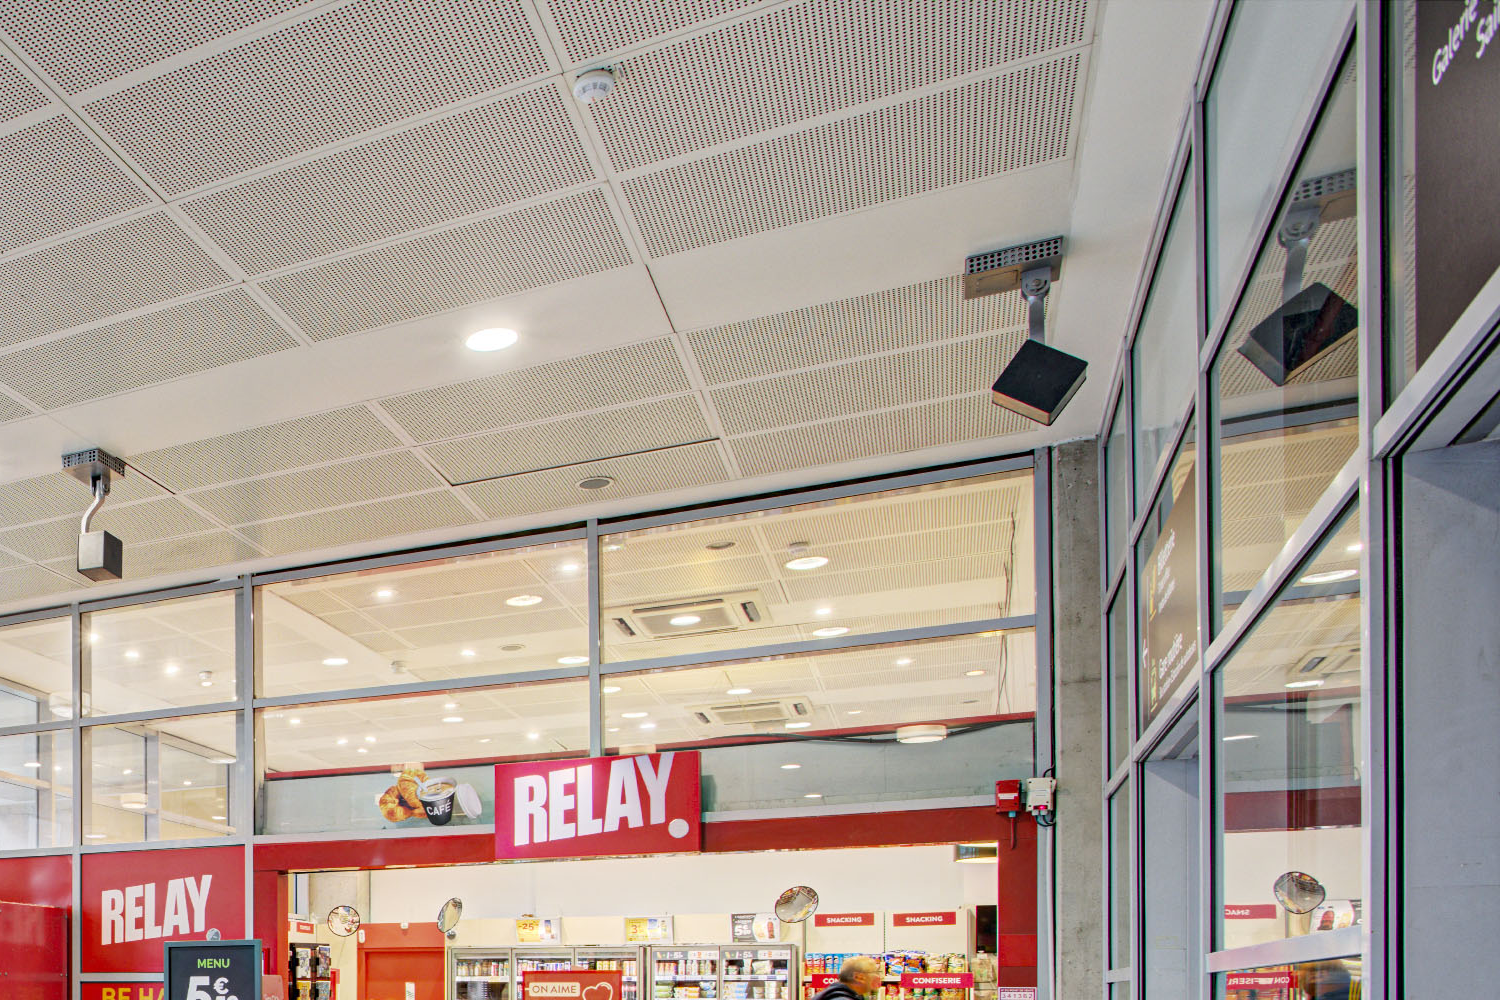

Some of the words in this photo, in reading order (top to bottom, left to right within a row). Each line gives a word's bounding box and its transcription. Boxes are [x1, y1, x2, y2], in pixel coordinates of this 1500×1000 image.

[426, 801, 452, 817] CAFÉ
[826, 916, 862, 924] SNACKING
[905, 915, 944, 923] SNACKING
[197, 958, 231, 969] MENU
[822, 977, 838, 985] CON
[912, 977, 962, 985] CONFISERIE
[531, 985, 548, 994] ON
[550, 985, 577, 994] AIME
